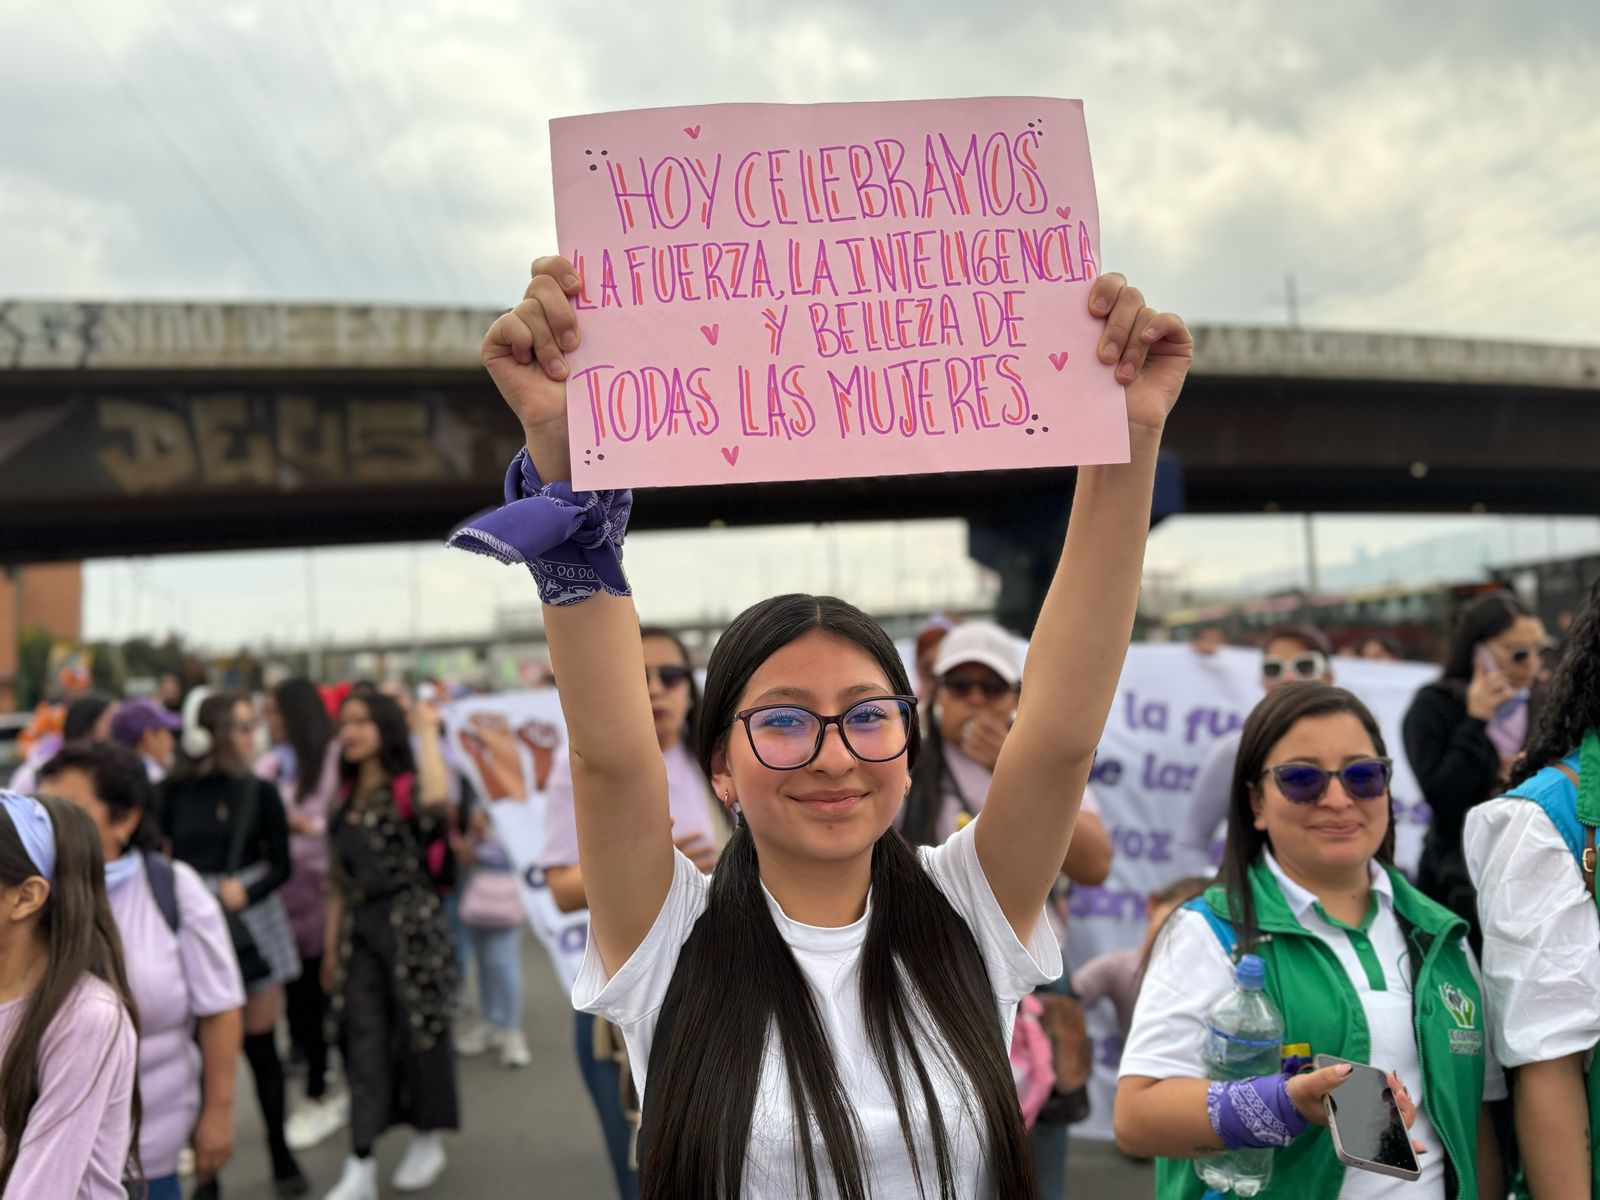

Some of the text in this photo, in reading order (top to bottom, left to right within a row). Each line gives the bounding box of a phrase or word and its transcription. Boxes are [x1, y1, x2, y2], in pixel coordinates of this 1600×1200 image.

[606, 130, 1048, 234] HOY CELEBRAMOS
[573, 220, 1099, 311] LA FUERZA, LA INTELIGENCIA
[761, 290, 1027, 358] Y BELLEZA DE
[572, 364, 720, 447] TODAS
[738, 363, 817, 441] LAS
[1125, 691, 1167, 734] la
